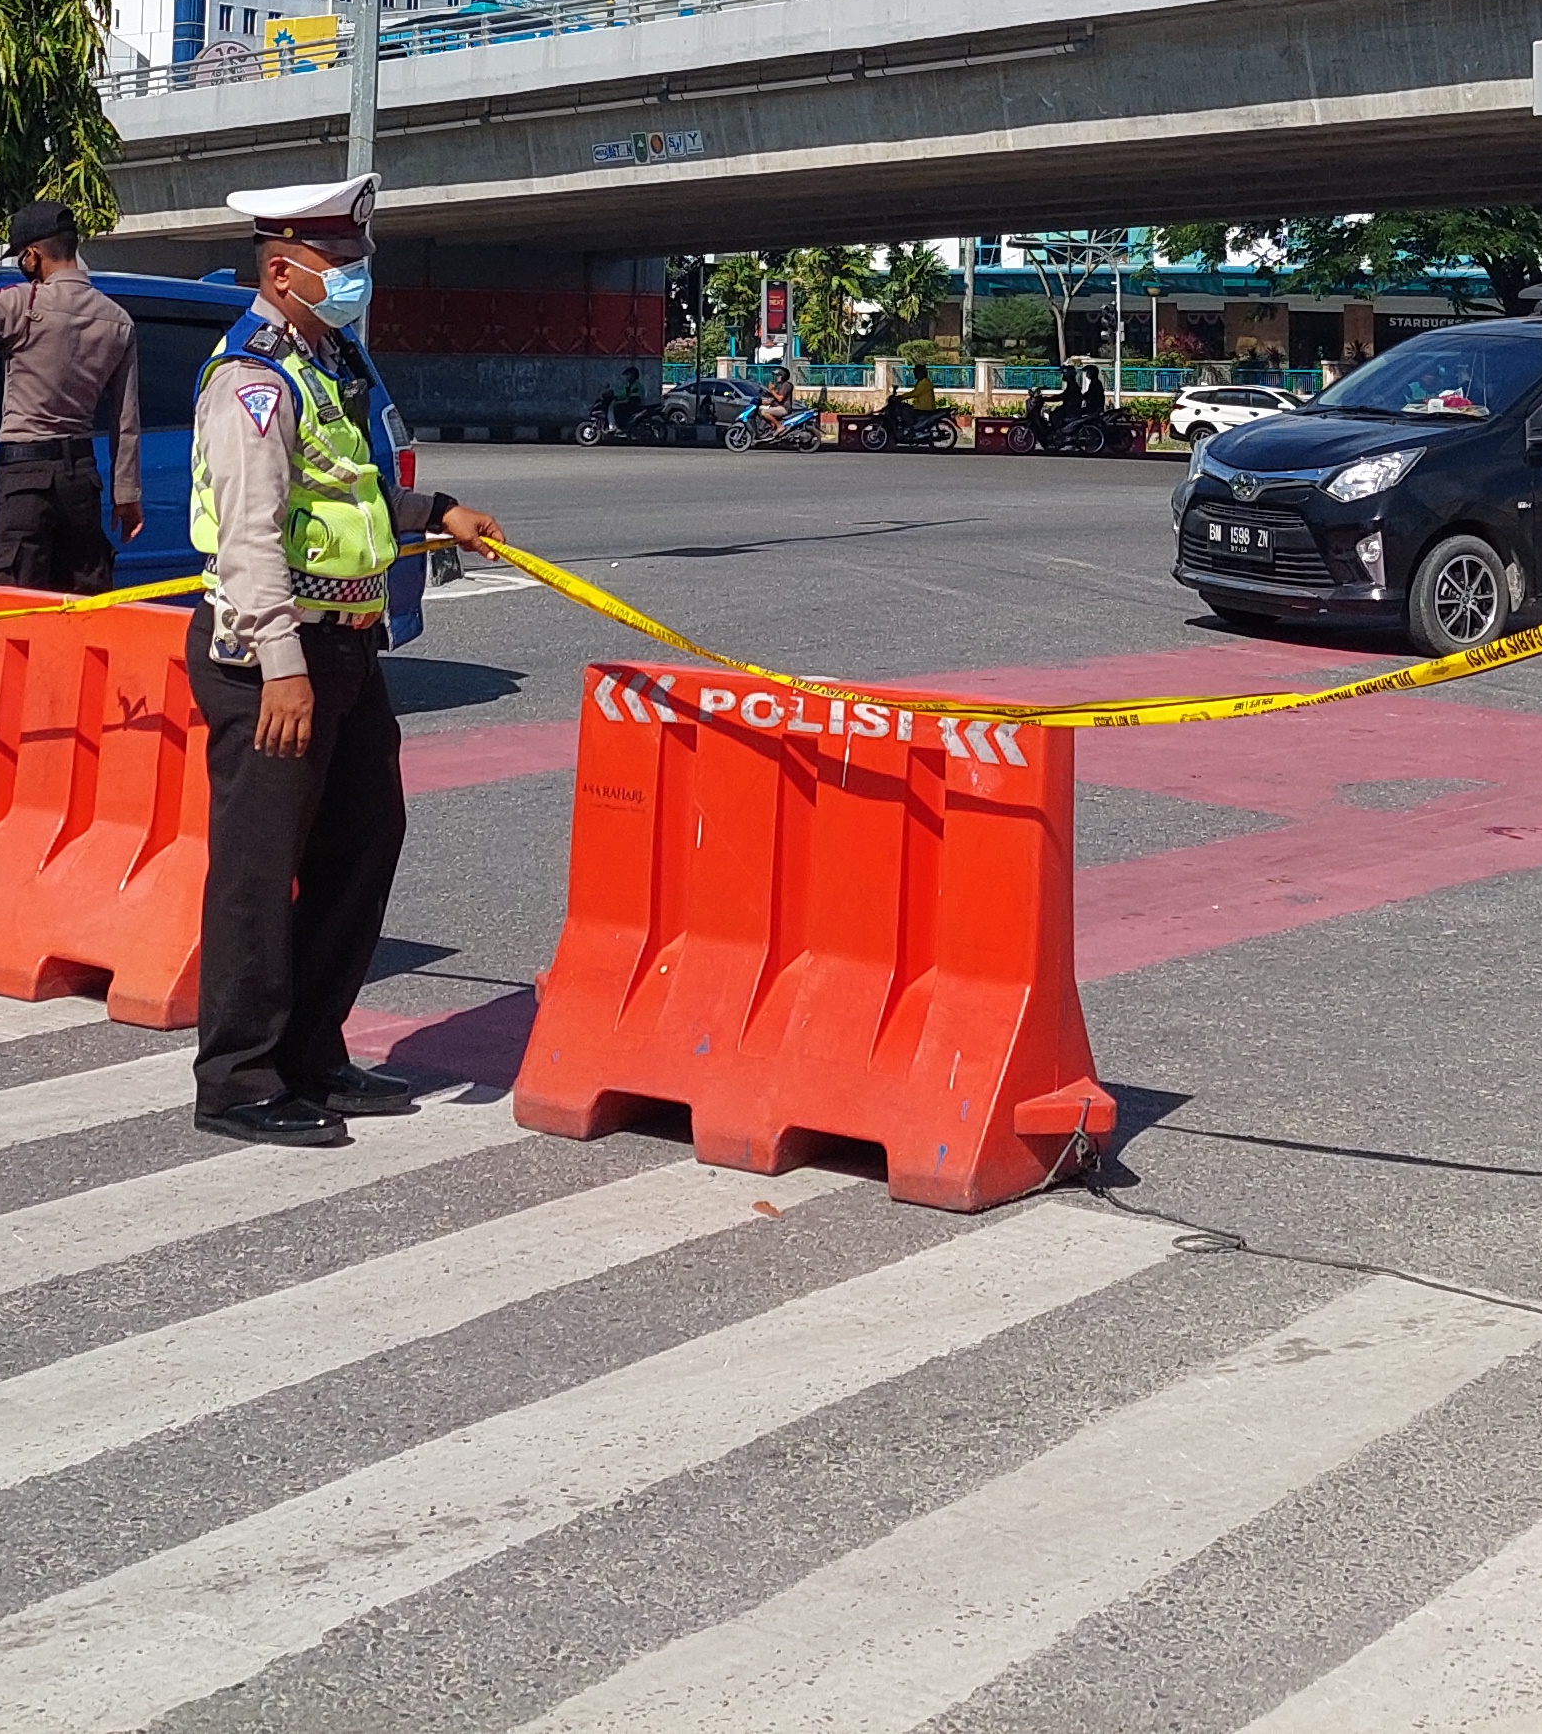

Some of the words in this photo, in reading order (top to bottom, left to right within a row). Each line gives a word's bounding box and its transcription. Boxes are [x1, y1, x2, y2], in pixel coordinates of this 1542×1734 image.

[1209, 523, 1222, 542] BM
[1230, 526, 1250, 545] 1598
[1257, 529, 1269, 548] ZN
[1465, 641, 1507, 669] POLISI
[698, 686, 914, 741] POLISI
